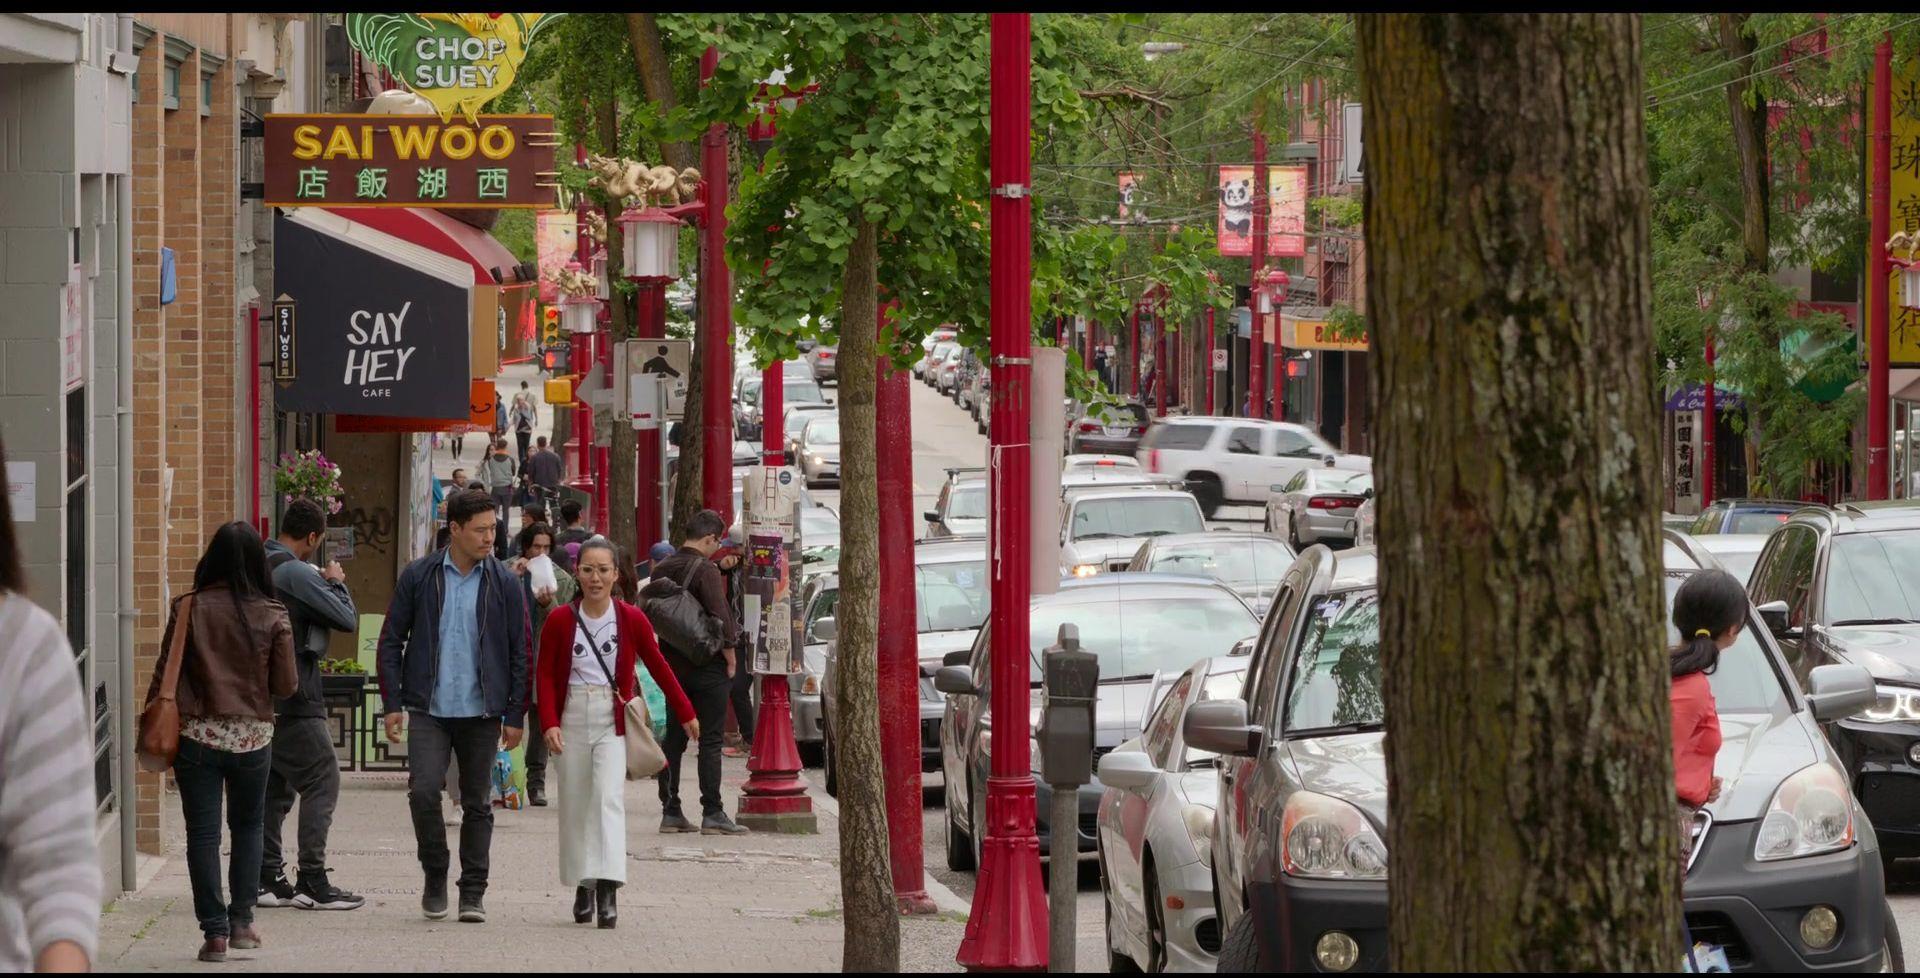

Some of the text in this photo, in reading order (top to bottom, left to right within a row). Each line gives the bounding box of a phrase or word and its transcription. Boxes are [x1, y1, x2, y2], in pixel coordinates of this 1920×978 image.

[415, 36, 506, 61] CHOP
[415, 64, 500, 89] SUEY
[292, 124, 516, 160] SAI WOO
[281, 308, 289, 332] SAI
[346, 301, 412, 345] SAY
[279, 334, 290, 359] WOO
[343, 346, 417, 386] HEY
[362, 389, 391, 397] CAFE
